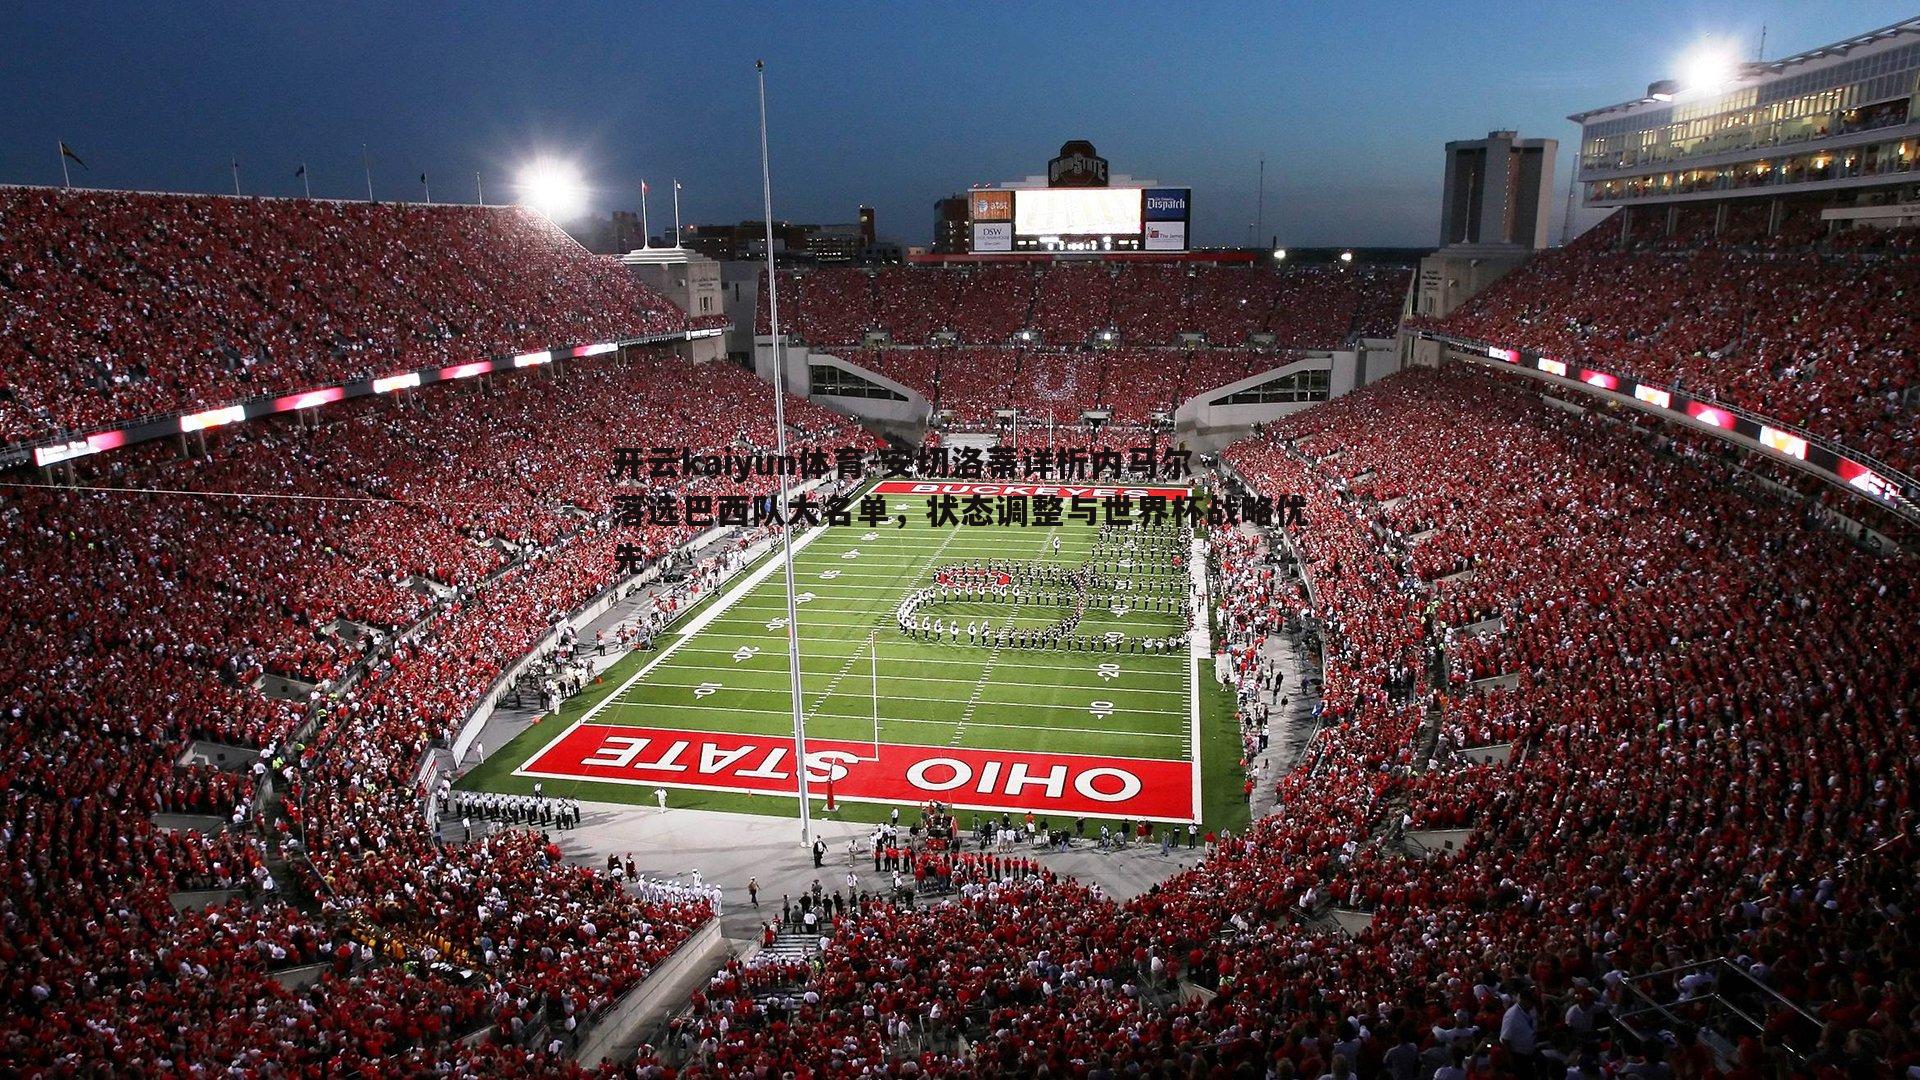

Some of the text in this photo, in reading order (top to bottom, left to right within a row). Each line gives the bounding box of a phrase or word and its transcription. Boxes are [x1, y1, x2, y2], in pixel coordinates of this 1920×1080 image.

[1147, 197, 1185, 211] Dispatch
[911, 483, 1149, 498] BUCKEYES
[1097, 663, 1120, 678] 20
[693, 682, 723, 696] 10
[1089, 701, 1114, 714] 10
[580, 736, 1143, 802] OHIO STATE
